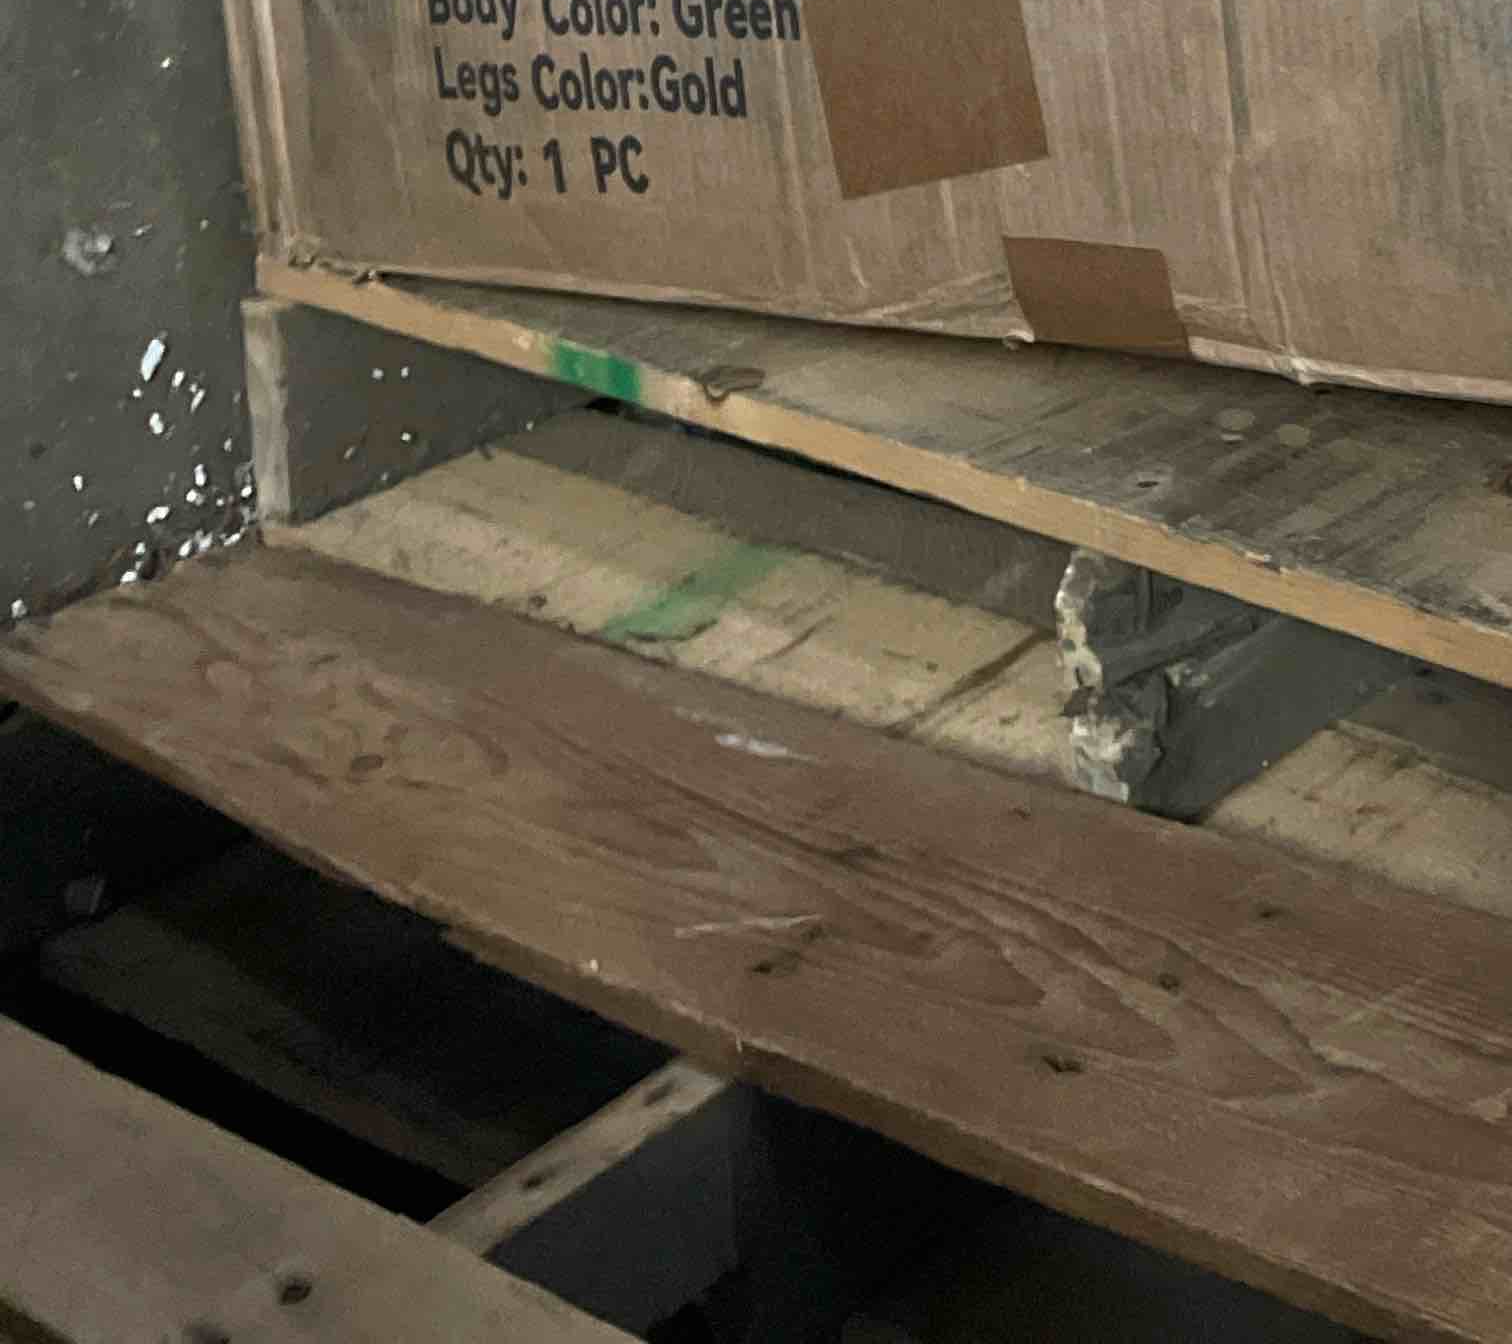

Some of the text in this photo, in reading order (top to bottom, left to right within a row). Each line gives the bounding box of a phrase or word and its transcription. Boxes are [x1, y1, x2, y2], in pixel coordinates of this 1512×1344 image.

[434, 46, 520, 116] Legs
[445, 128, 650, 201] Qty: 1 PC
